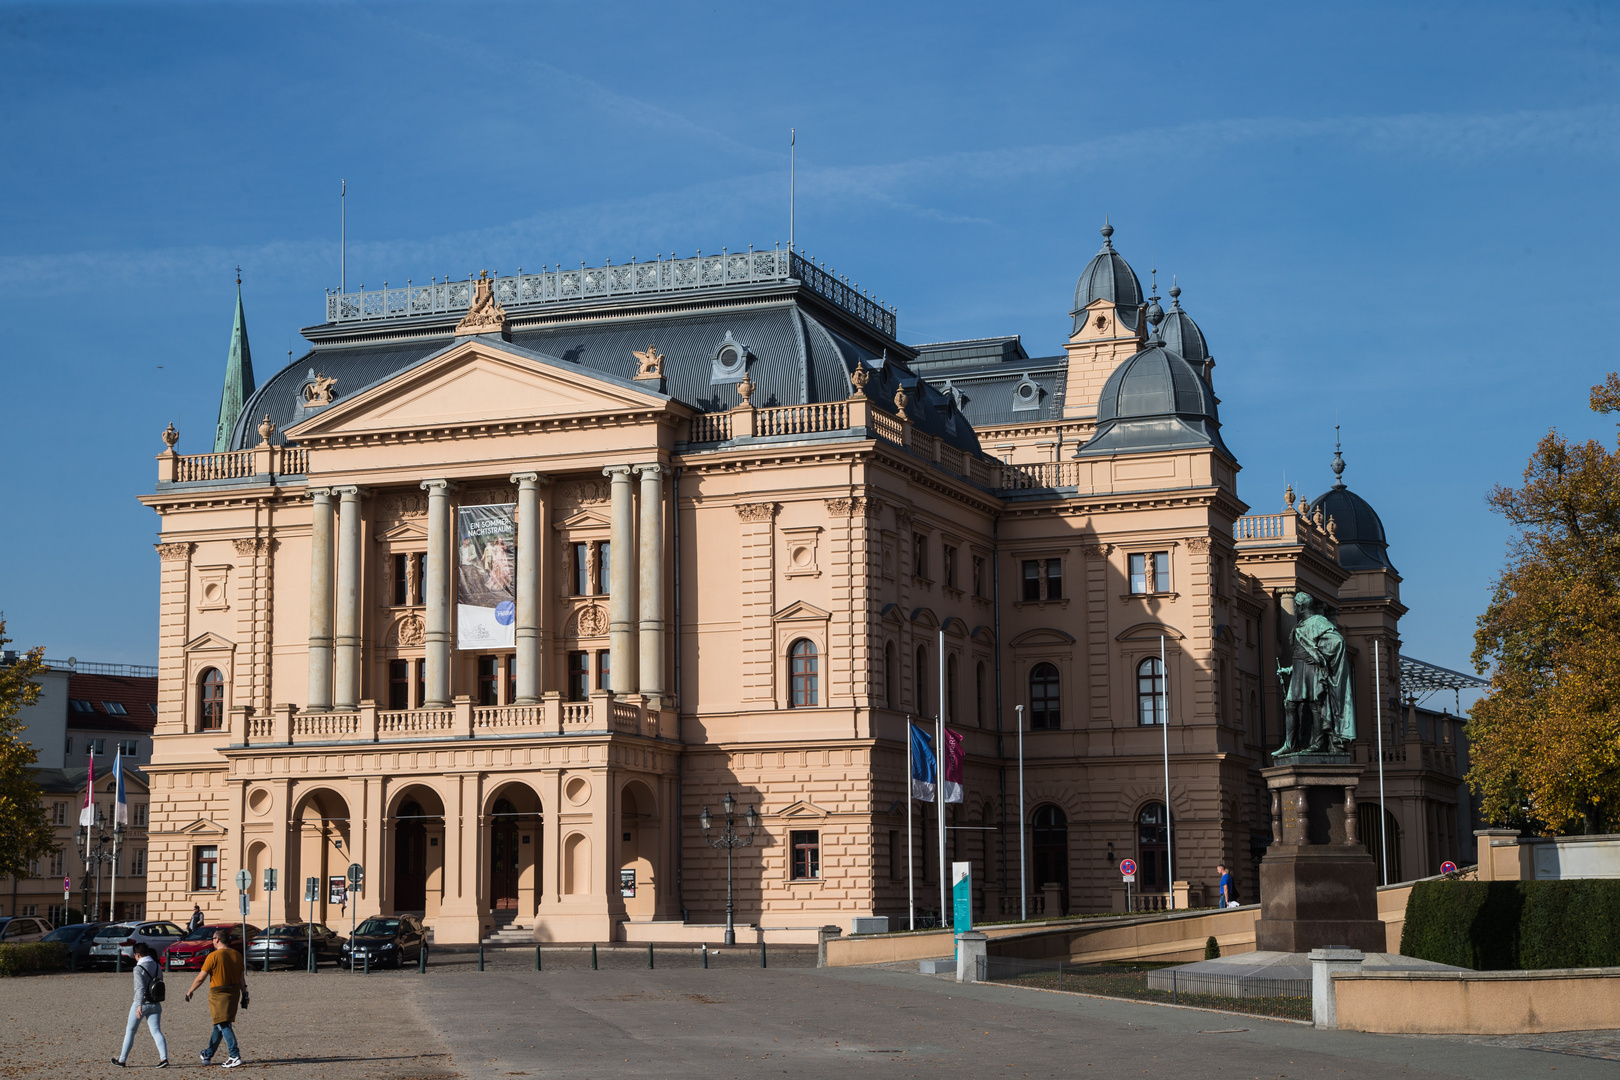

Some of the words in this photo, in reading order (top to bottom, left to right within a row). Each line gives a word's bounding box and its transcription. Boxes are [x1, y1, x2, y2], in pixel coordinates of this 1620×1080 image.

[470, 522, 480, 530] EIN
[481, 518, 511, 528] SOMMER-
[468, 525, 512, 537] NACHTSTRAUM
